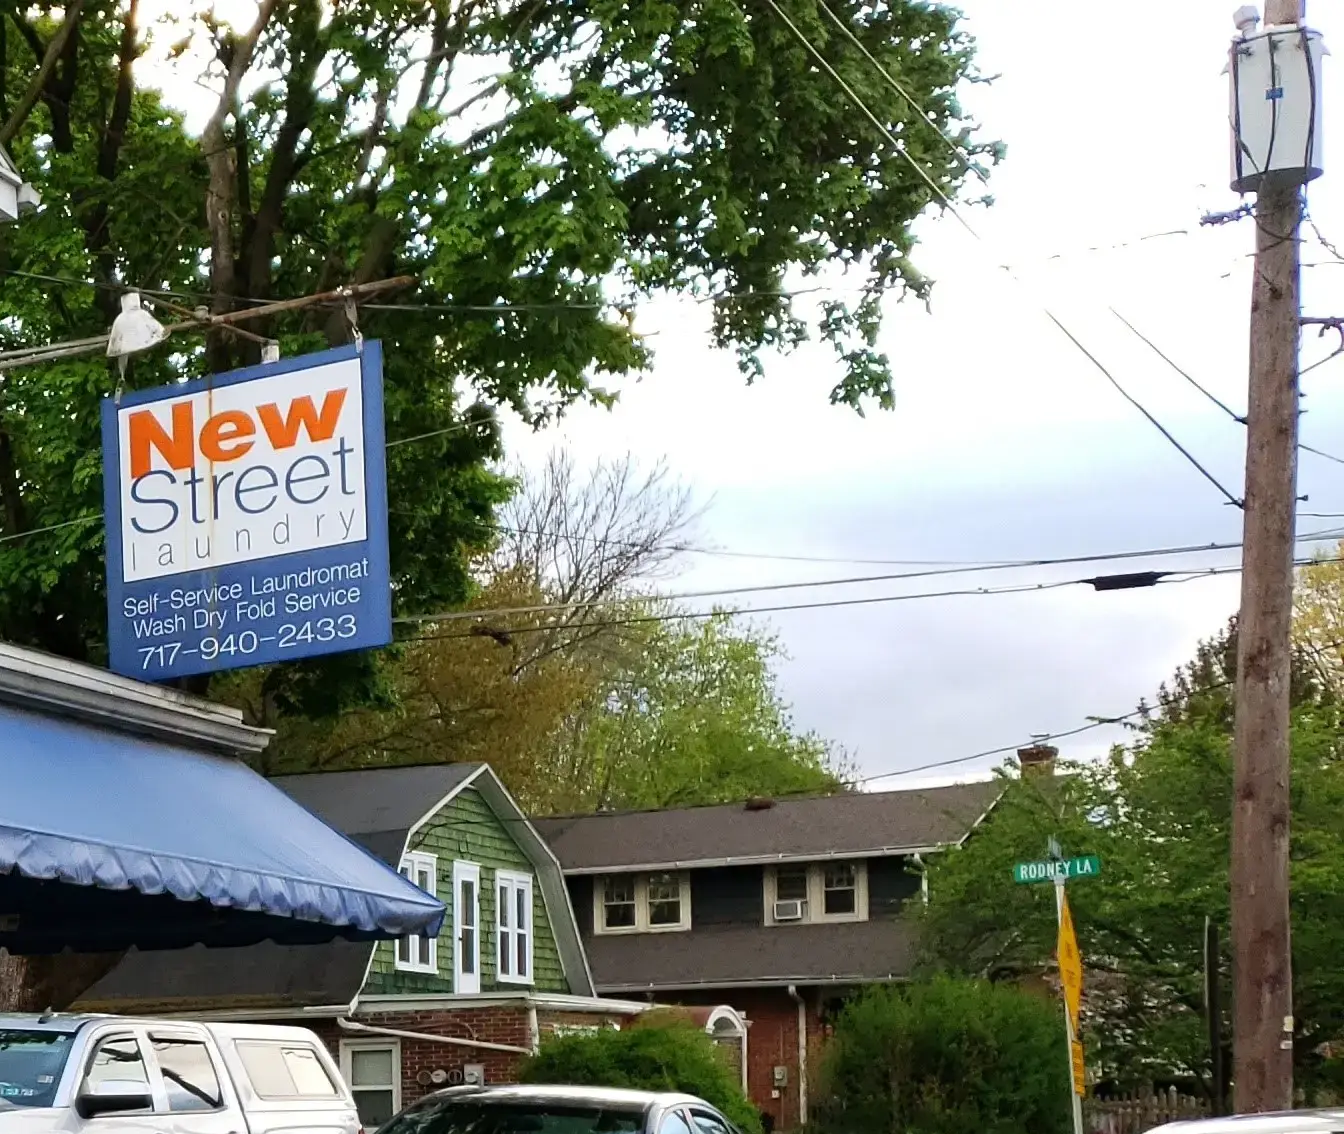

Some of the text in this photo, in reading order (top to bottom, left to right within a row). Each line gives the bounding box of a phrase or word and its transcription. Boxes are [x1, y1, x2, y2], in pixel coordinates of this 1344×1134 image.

[128, 388, 348, 480] New
[130, 436, 356, 534] Street
[131, 508, 355, 571] laundry
[123, 557, 369, 618] Self-Service Laundromat
[132, 586, 361, 639] Wash Dry Fold Service
[138, 614, 357, 670] 717-940-2433
[1020, 859, 1092, 880] RODNEY LA
